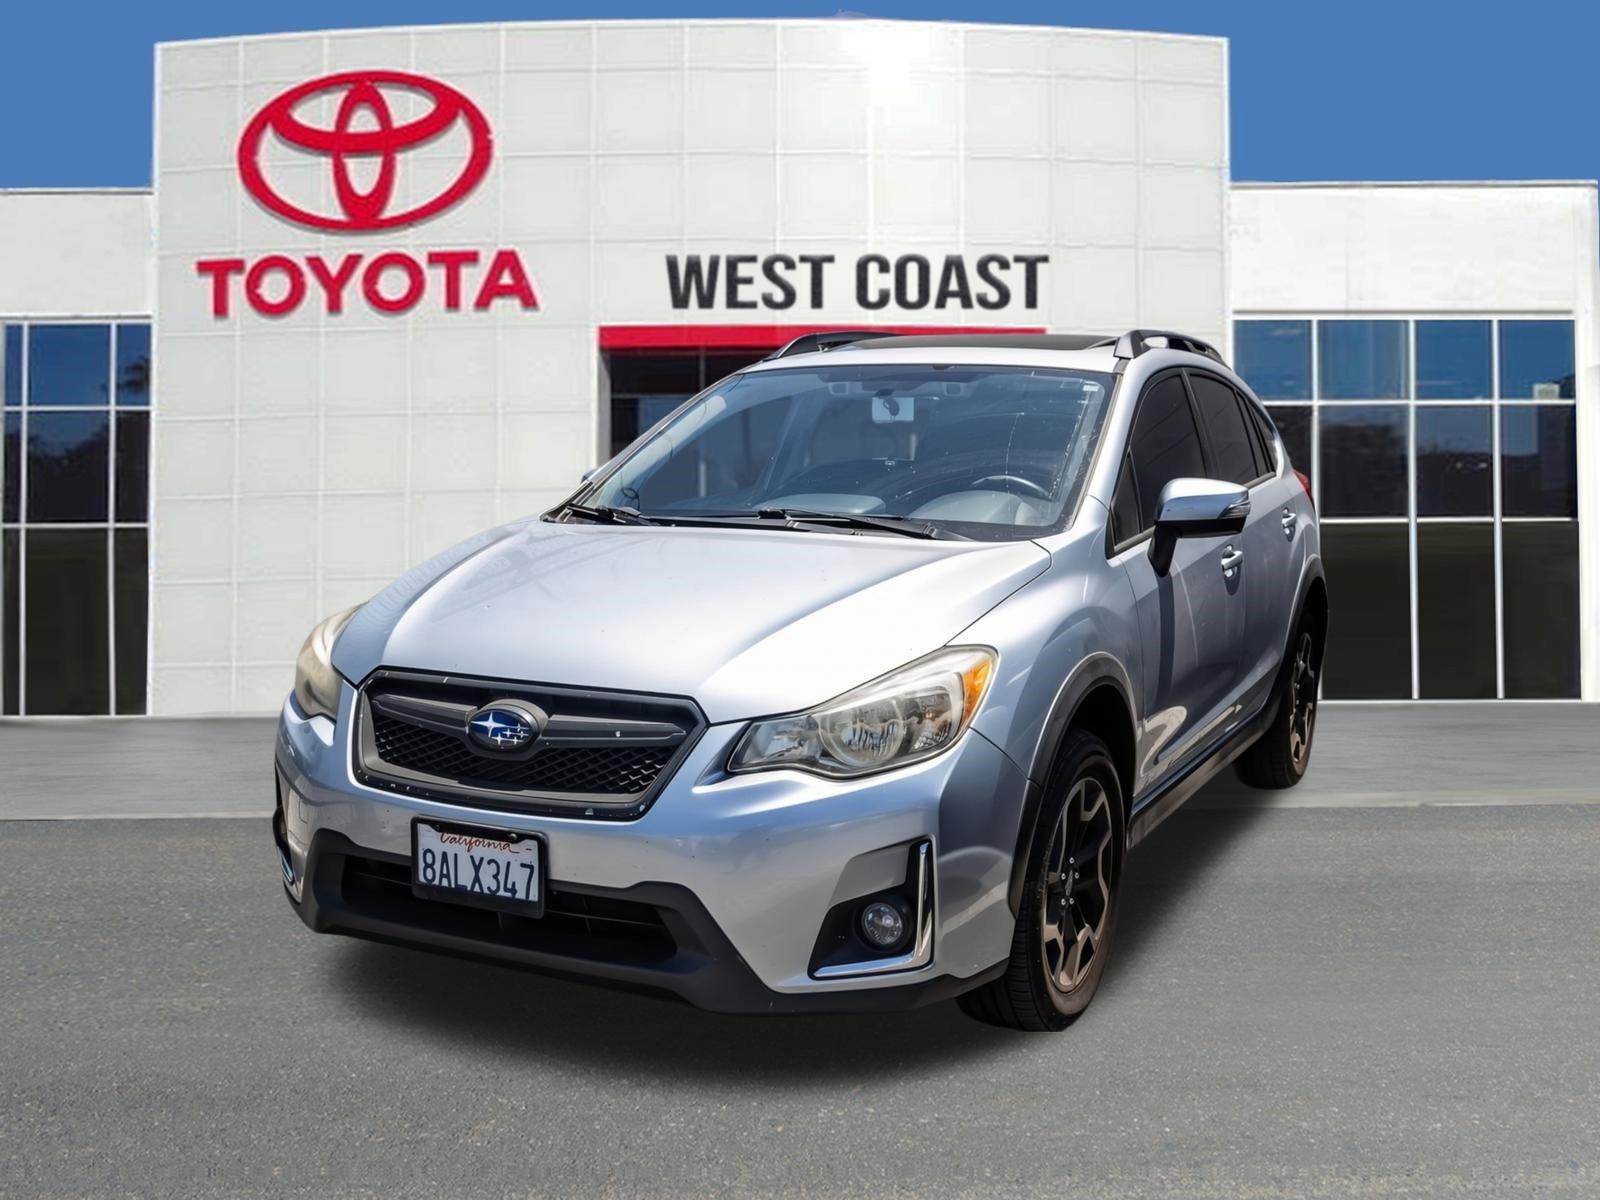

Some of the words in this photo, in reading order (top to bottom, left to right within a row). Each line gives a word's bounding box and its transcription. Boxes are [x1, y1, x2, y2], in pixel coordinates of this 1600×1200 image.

[196, 249, 538, 317] TOYOTA
[665, 254, 835, 310] WEST
[855, 254, 1049, 310] COAST
[440, 832, 520, 854] California
[422, 848, 535, 901] 8ALX347
